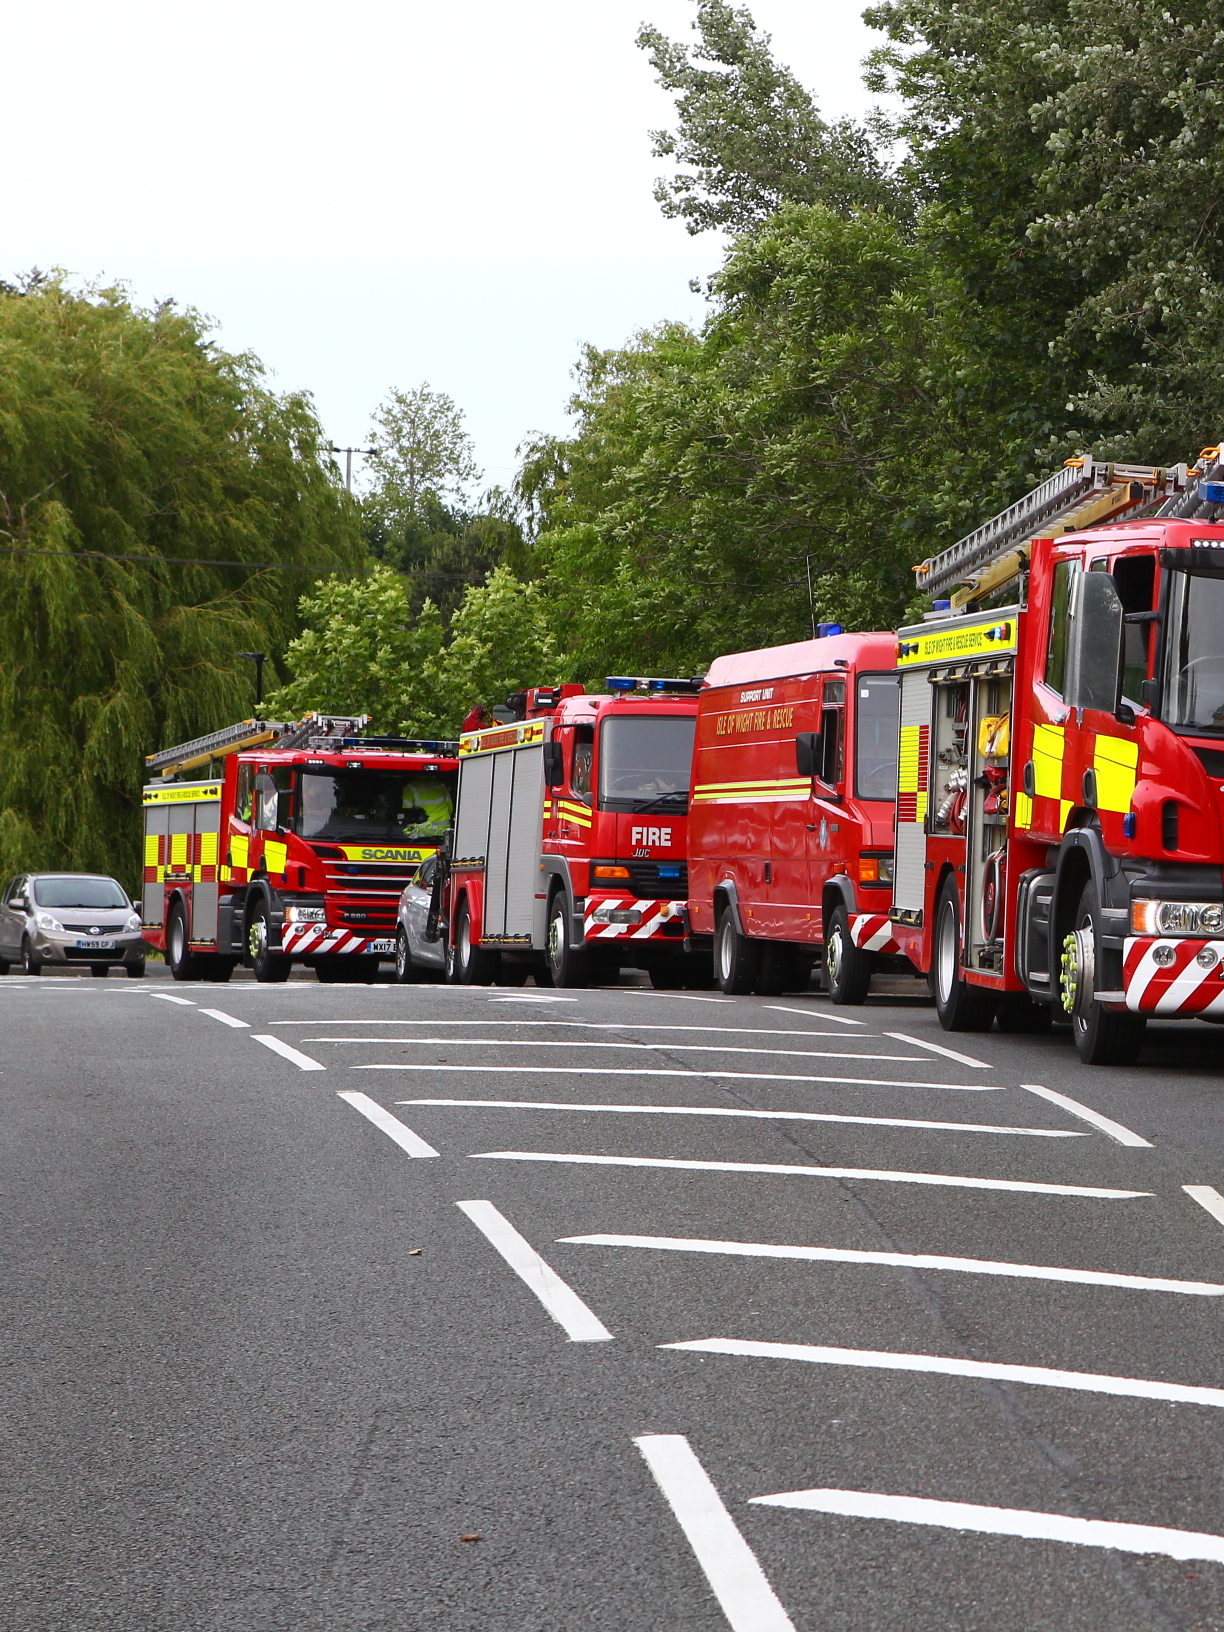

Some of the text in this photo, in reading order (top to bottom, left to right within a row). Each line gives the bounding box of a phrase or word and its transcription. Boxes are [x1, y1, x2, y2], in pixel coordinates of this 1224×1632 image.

[740, 687, 774, 703] SUPPORT UNIT
[716, 707, 794, 736] ISLE OF WIGHT FIRE & RESCUE
[631, 826, 672, 847] FIRE
[361, 848, 423, 860] SCANIA
[82, 940, 115, 948] HW59 GFJ
